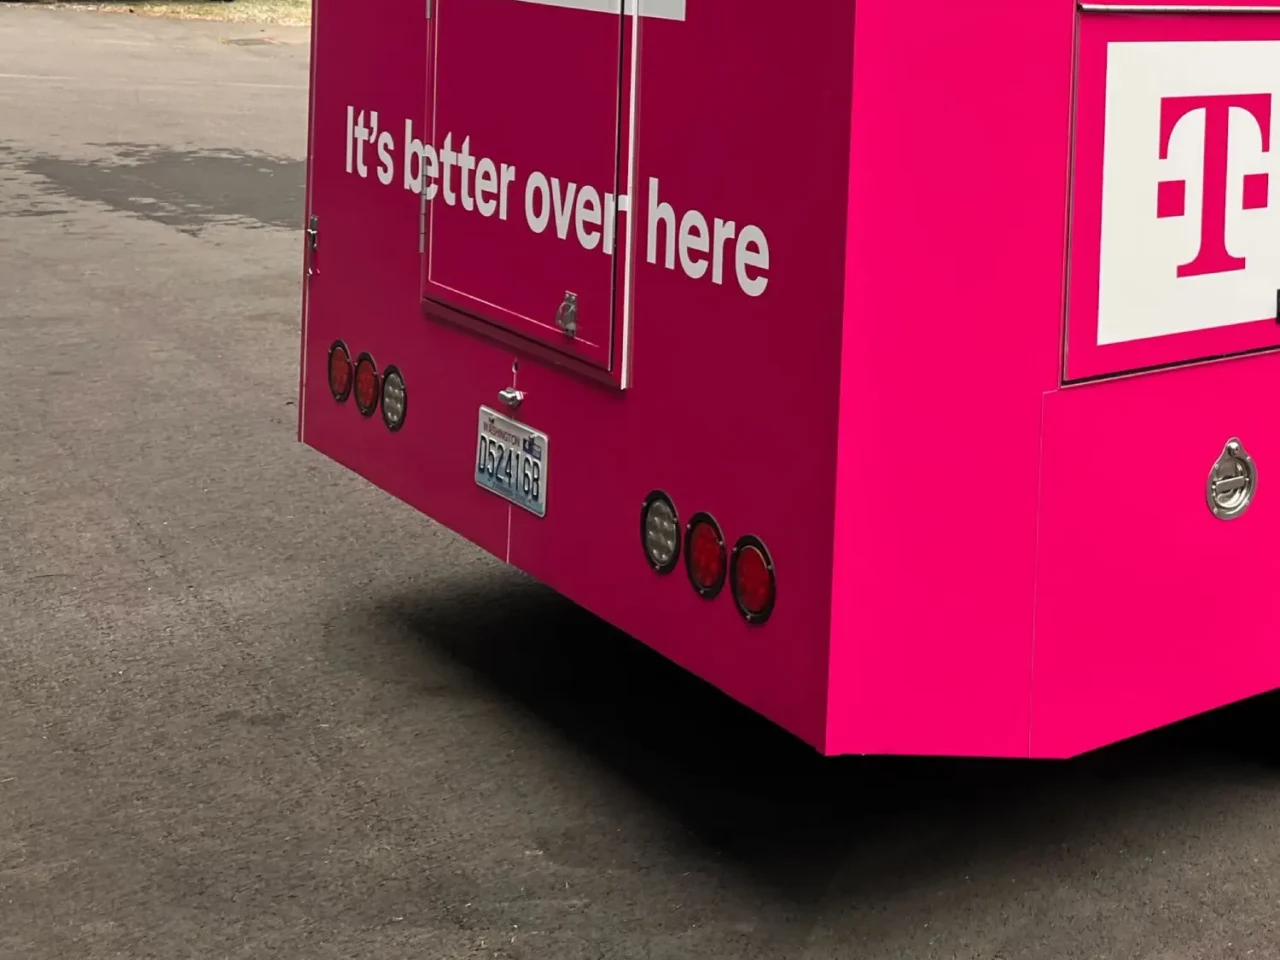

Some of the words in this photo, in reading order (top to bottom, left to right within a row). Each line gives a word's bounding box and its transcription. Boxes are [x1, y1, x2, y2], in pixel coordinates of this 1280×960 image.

[403, 118, 516, 221] better
[525, 171, 630, 255] over
[646, 176, 770, 297] here
[483, 421, 521, 447] WASHINGTON
